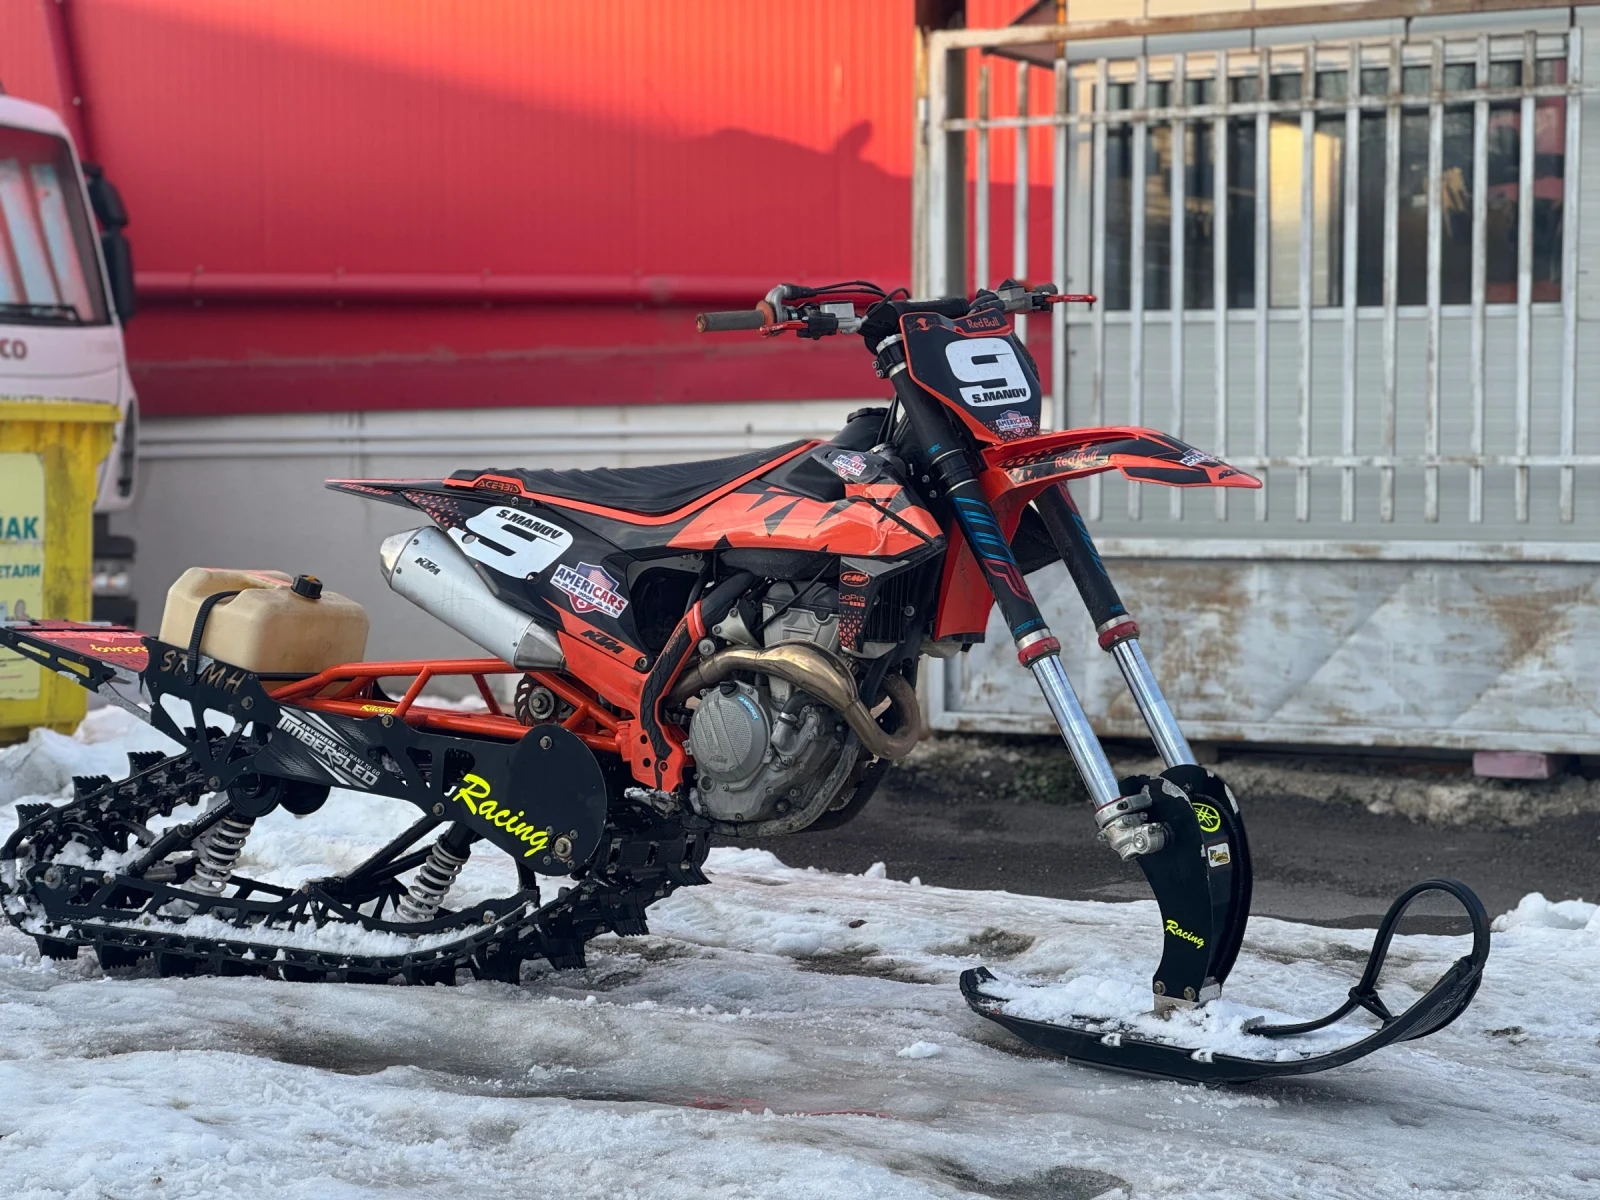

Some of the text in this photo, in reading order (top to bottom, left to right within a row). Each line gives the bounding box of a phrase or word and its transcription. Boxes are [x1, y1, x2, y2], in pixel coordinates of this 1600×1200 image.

[966, 316, 1000, 329] Red Bull
[945, 338, 1031, 407] 9
[972, 388, 1027, 404] S.MANOV
[997, 417, 1031, 427] AMERICARS
[1055, 450, 1098, 468] Red Bull
[0, 516, 38, 538] АК
[496, 509, 563, 539] S.MANOV
[414, 557, 441, 575] KTM
[555, 567, 626, 610] AMERICARS
[839, 593, 866, 602] GoPro
[580, 630, 625, 654] KTM
[276, 708, 378, 785] TIMBERSLED
[300, 723, 337, 748] ANYWHERE
[338, 746, 349, 756] YOU
[349, 753, 365, 765] WANT
[371, 768, 381, 776] GO
[452, 774, 549, 857] Racing
[1165, 919, 1204, 949] Racing
